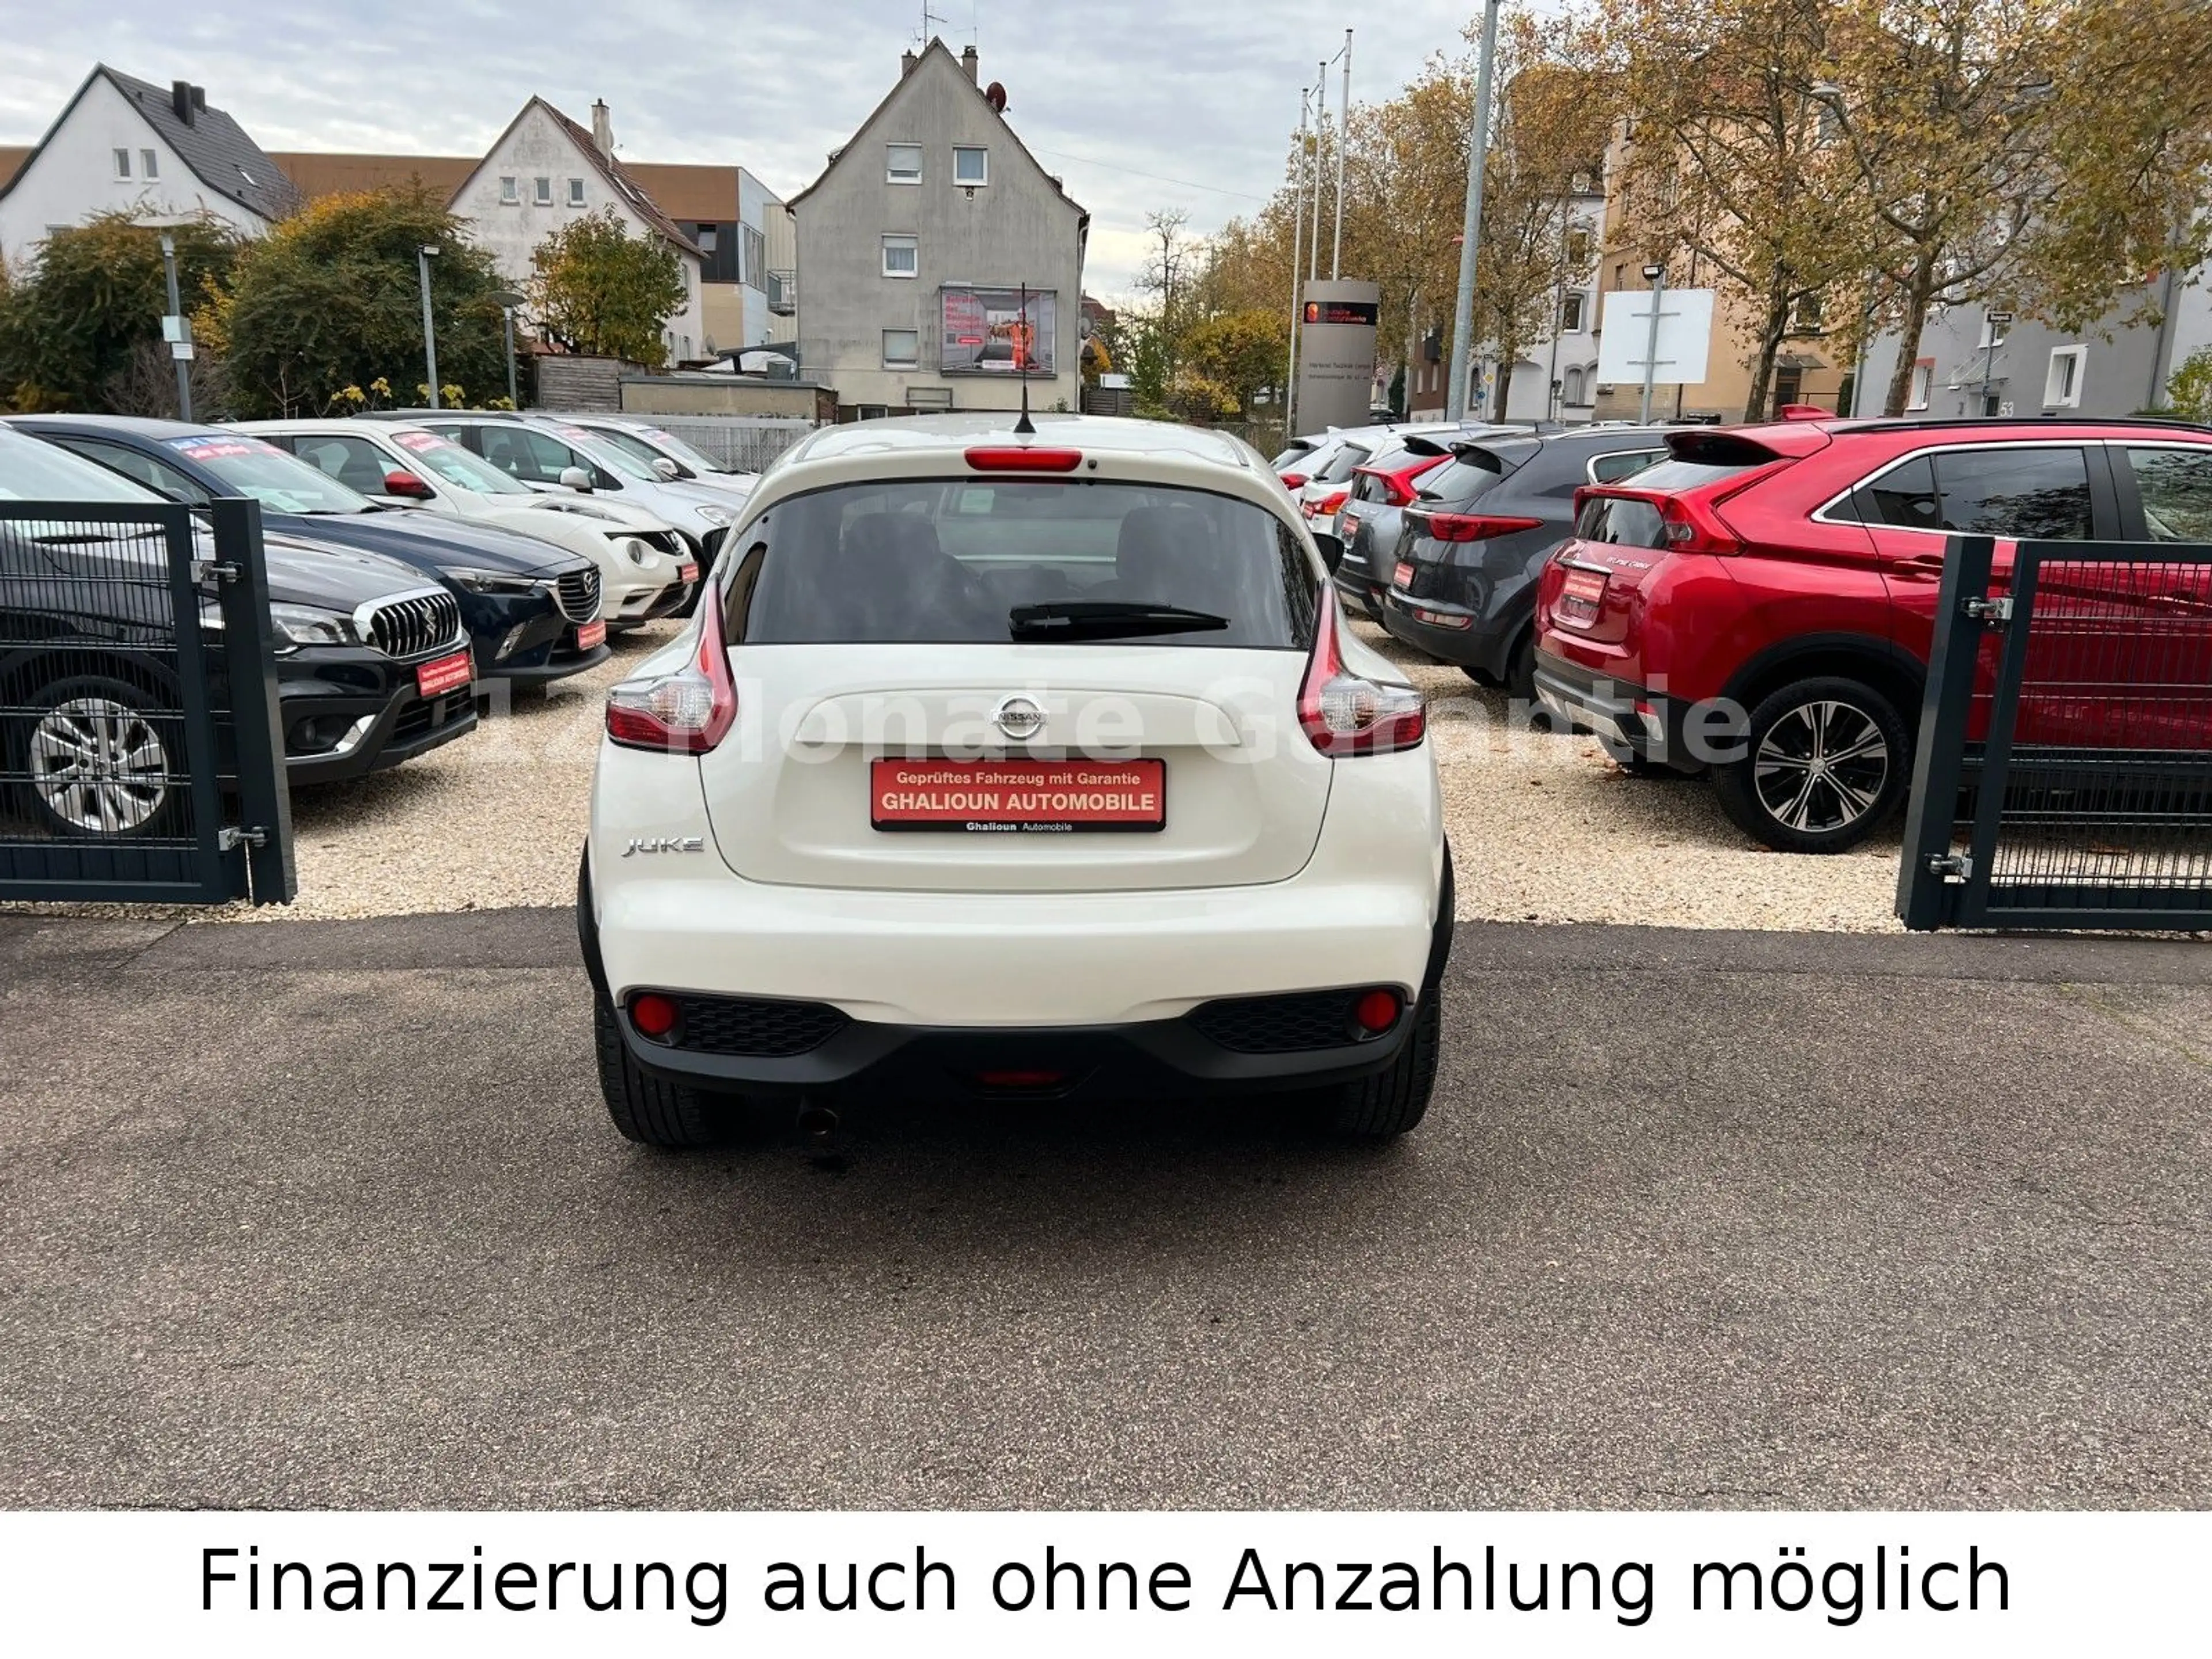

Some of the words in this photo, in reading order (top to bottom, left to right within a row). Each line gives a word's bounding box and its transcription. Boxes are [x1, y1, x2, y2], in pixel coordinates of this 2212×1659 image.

[1999, 402, 2014, 416] 53
[998, 711, 1041, 722] NISSAN
[896, 771, 972, 786] Geprüftes
[975, 772, 1045, 787] Fahrzeug
[1049, 772, 1073, 785] mit
[1077, 772, 1141, 785] Garantie
[881, 792, 999, 810] GHALIOUN
[1006, 793, 1155, 811] AUTOMOBILE
[966, 821, 1017, 831] Ghalioun
[1022, 822, 1073, 832] Automobile
[621, 838, 704, 858] JUKE
